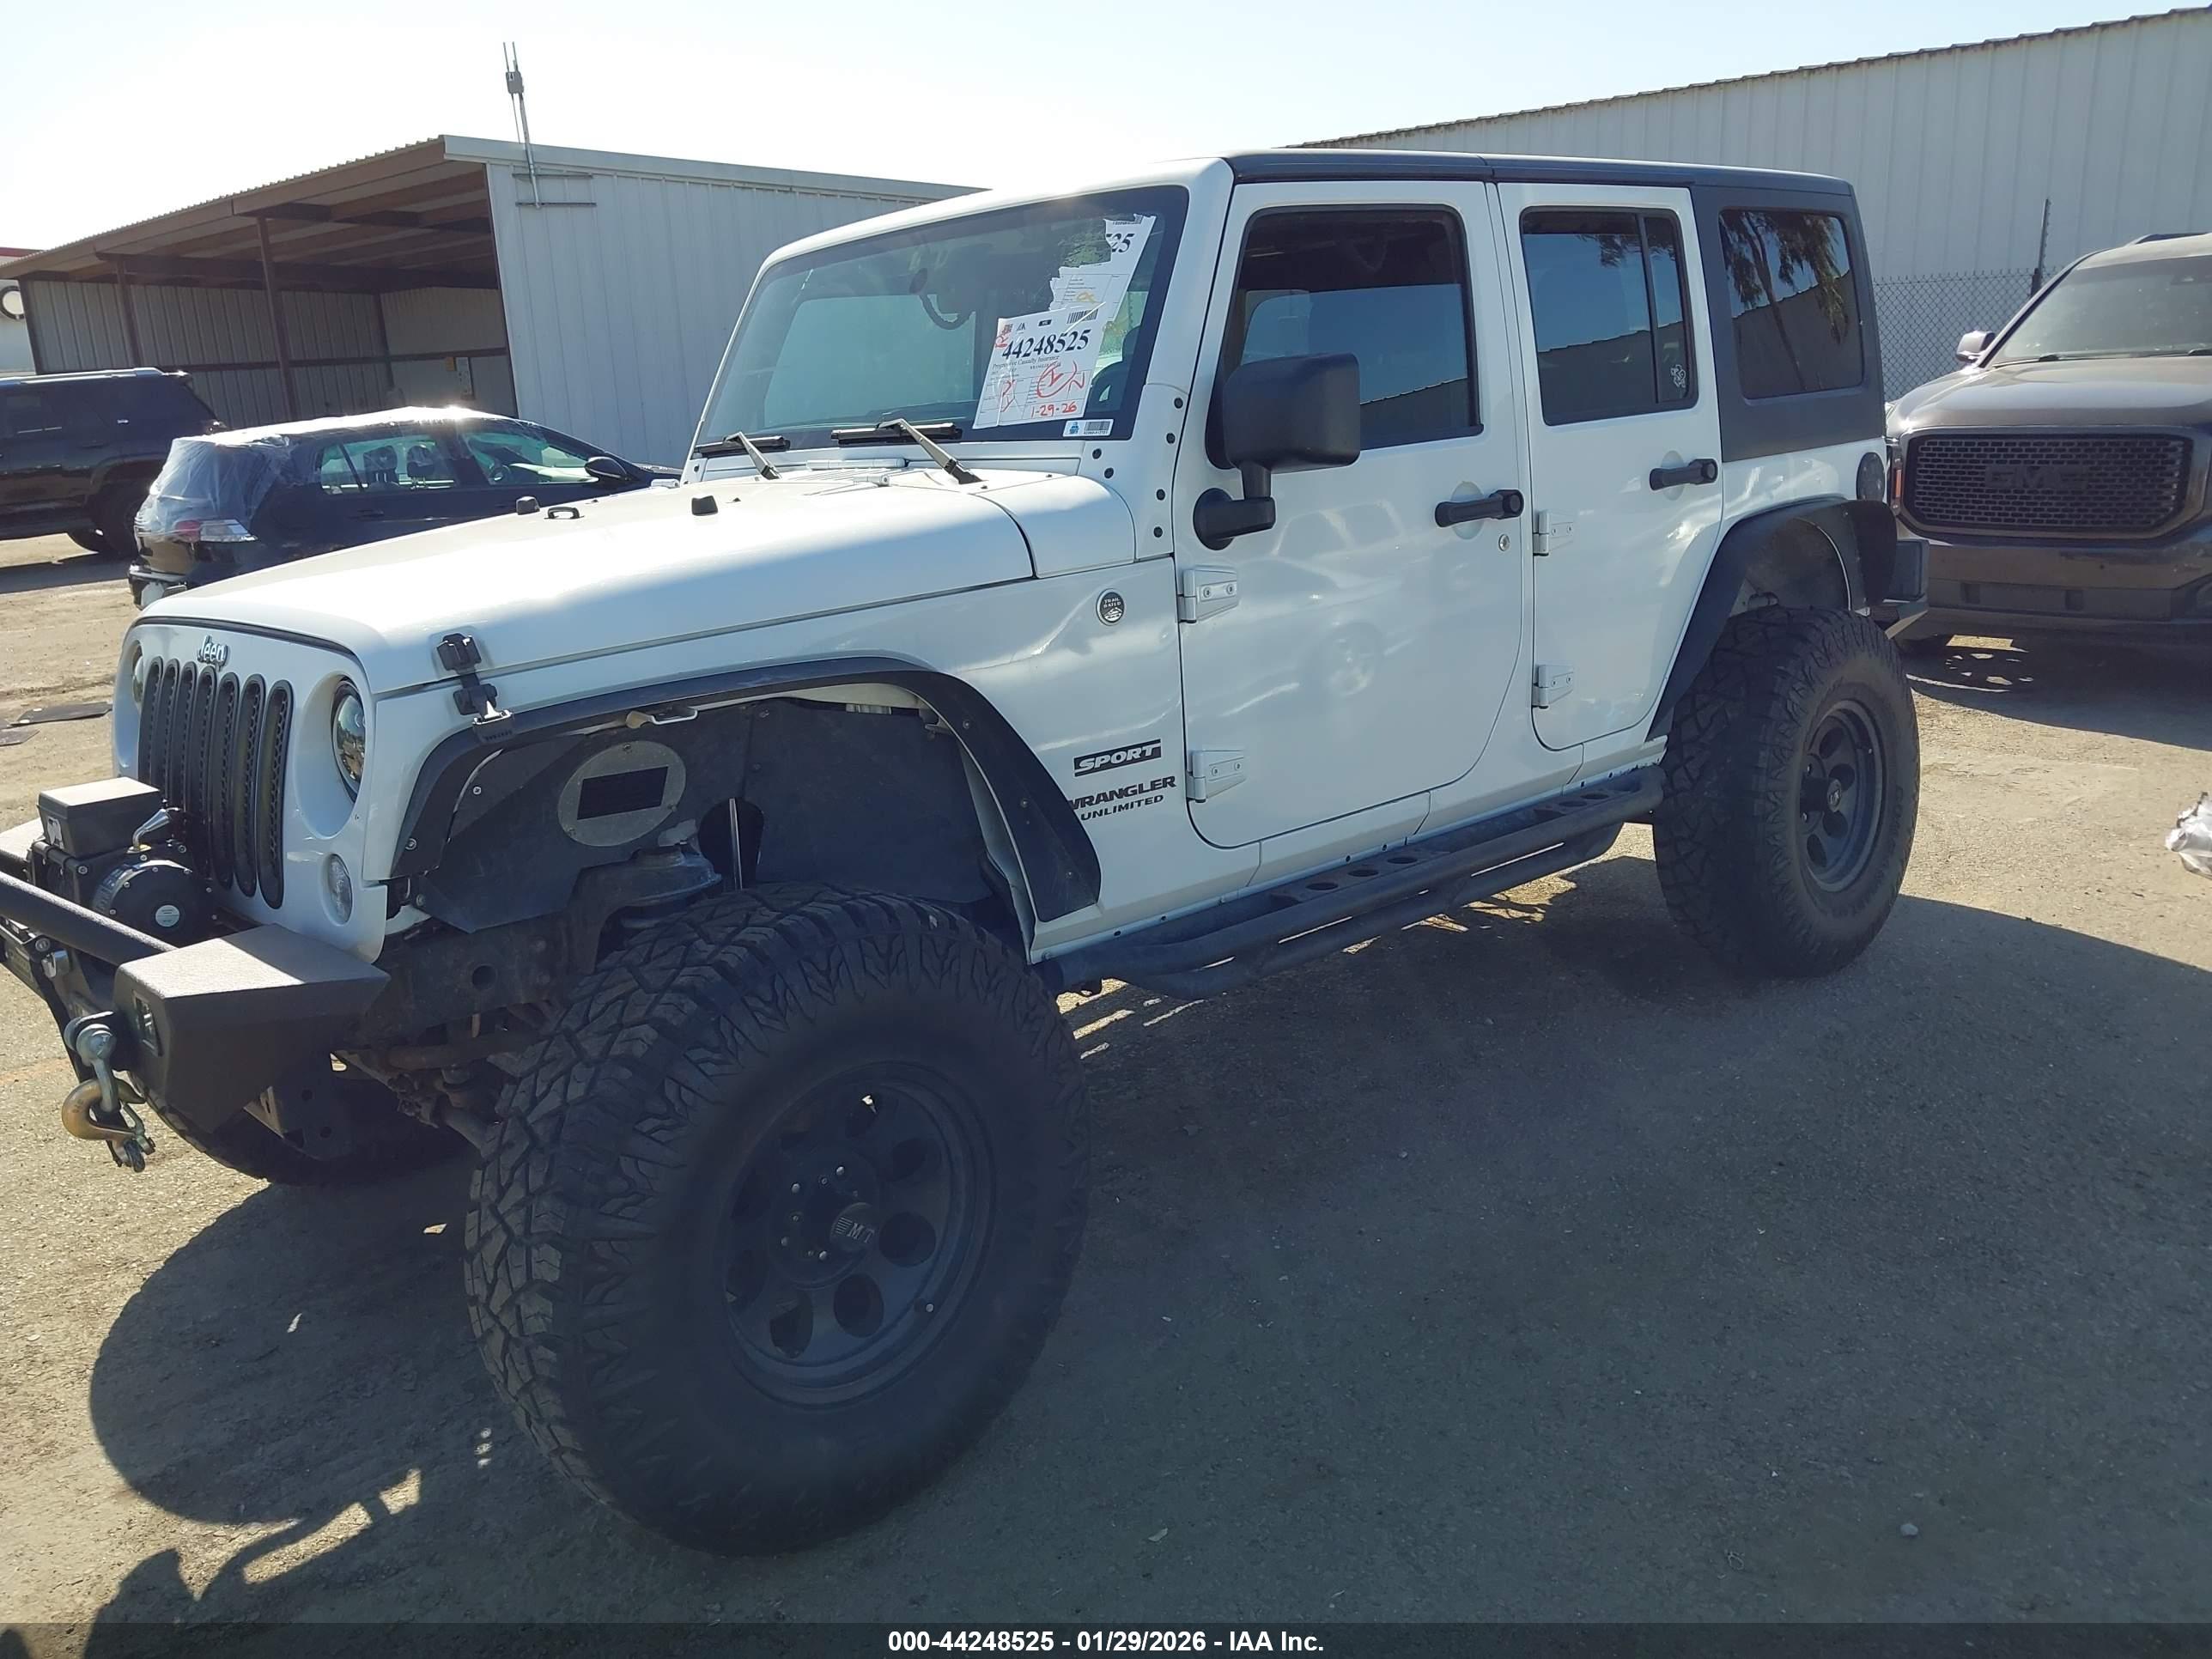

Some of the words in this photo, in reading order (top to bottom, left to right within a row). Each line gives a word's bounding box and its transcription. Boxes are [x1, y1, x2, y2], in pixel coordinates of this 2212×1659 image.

[1002, 328, 1091, 360] 44248525
[1079, 745, 1156, 769] SPORT
[1080, 794, 1164, 821] UNLIMITED
